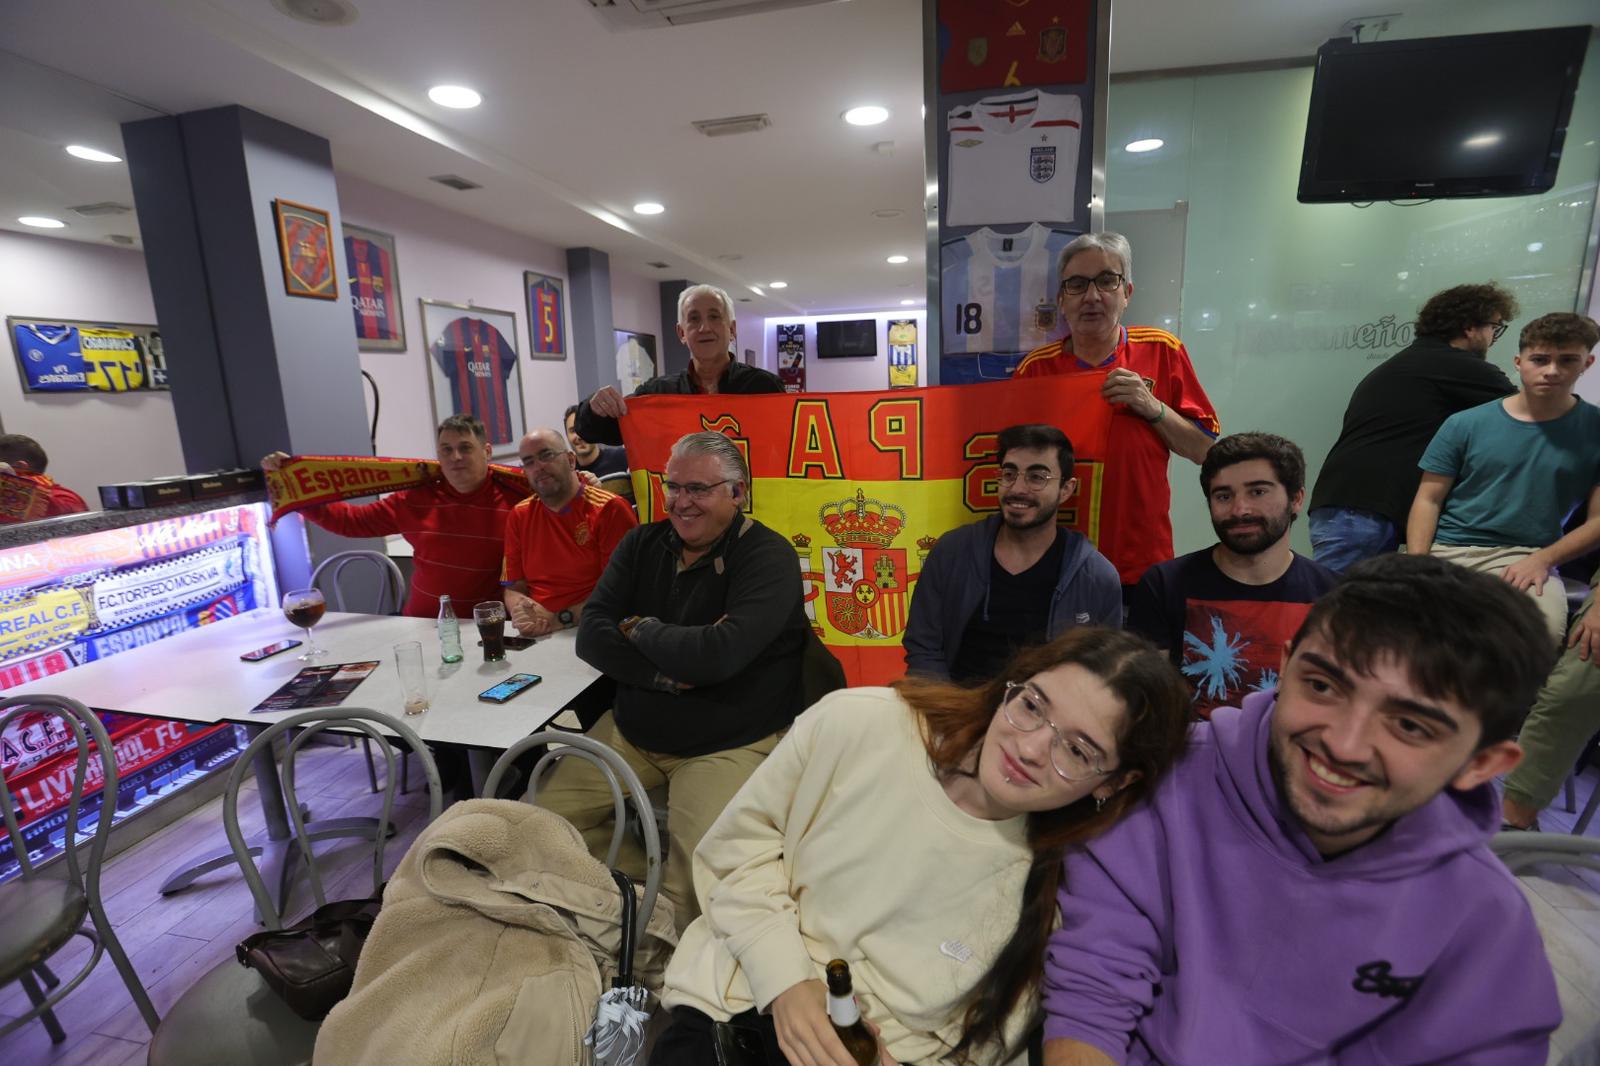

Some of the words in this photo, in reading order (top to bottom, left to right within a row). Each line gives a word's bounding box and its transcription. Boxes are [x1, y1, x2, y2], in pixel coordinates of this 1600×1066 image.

[351, 296, 384, 311] QATAR
[543, 306, 554, 343] 5
[955, 303, 983, 335] 18
[0, 610, 54, 636] REAL
[154, 721, 183, 747] FC
